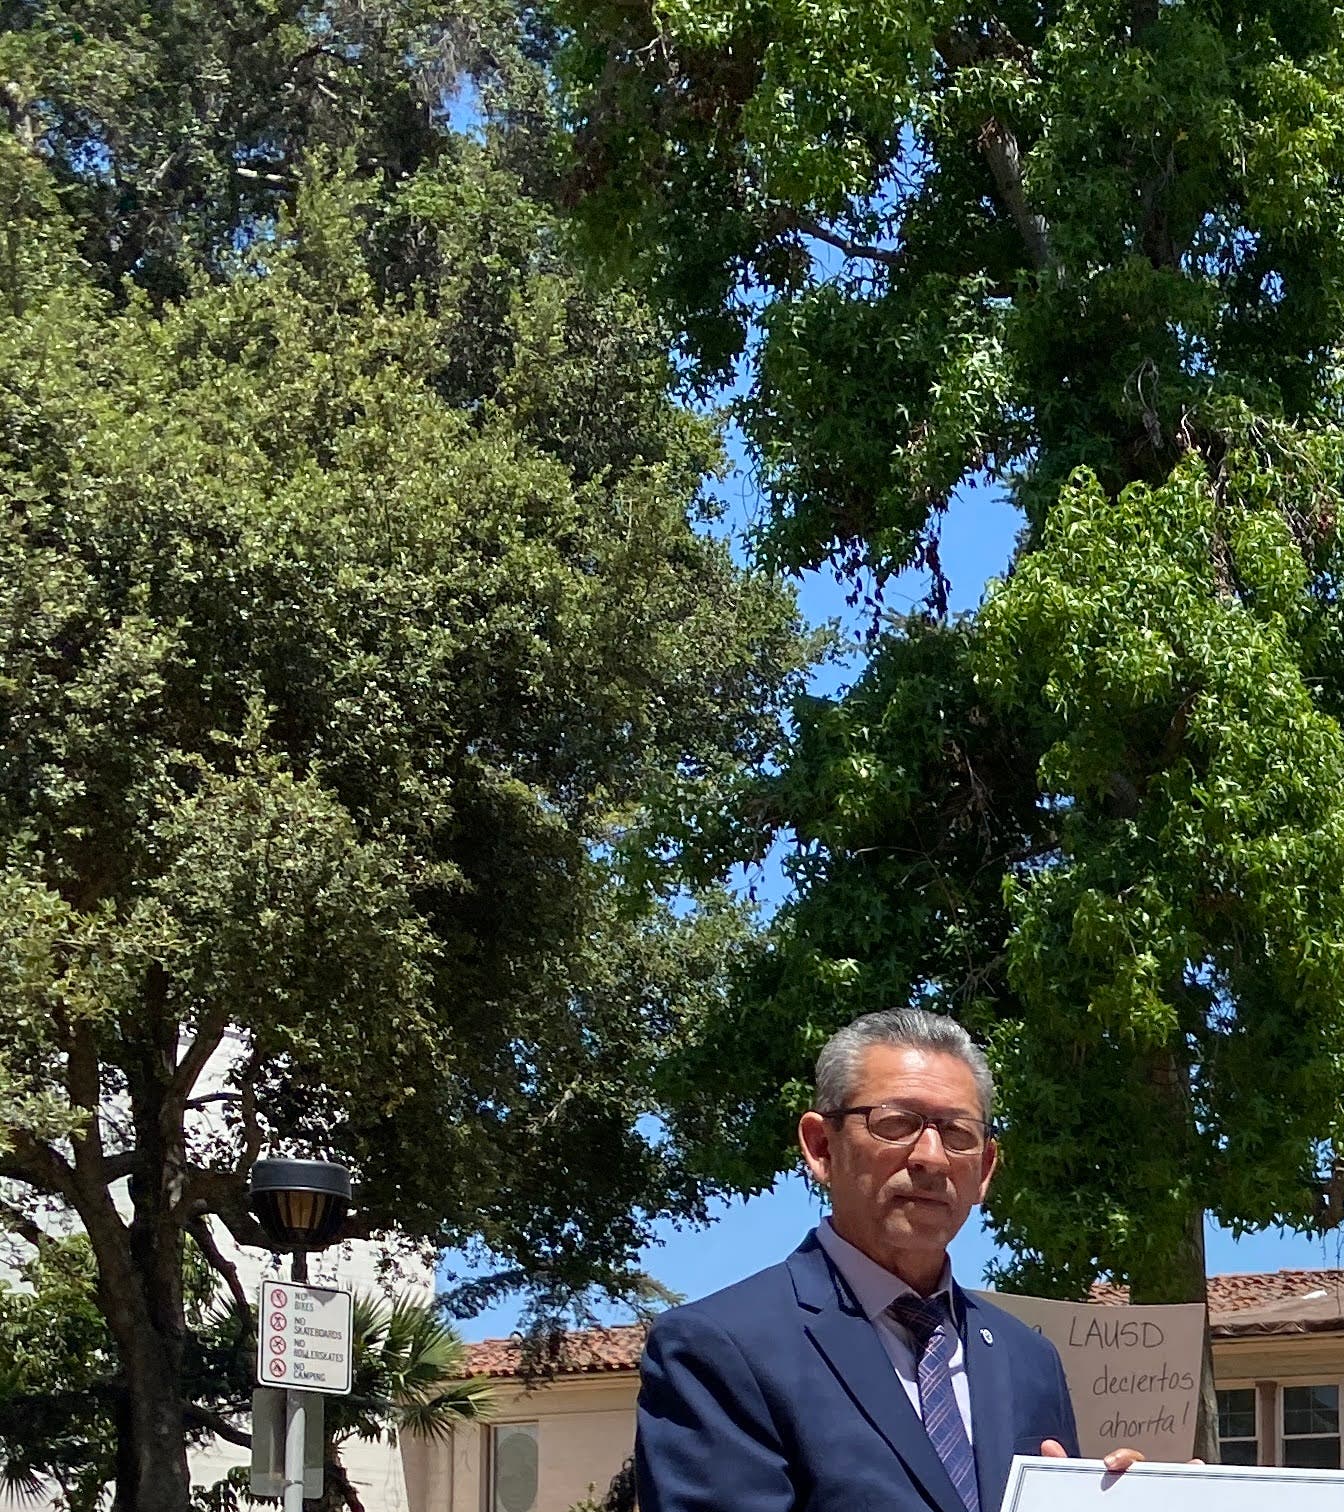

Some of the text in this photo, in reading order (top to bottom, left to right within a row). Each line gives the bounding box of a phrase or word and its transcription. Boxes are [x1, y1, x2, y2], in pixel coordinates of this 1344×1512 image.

[294, 1317, 306, 1326] NO
[1068, 1315, 1165, 1350] LAUSD
[294, 1339, 306, 1347] NO
[293, 1362, 305, 1371] NO
